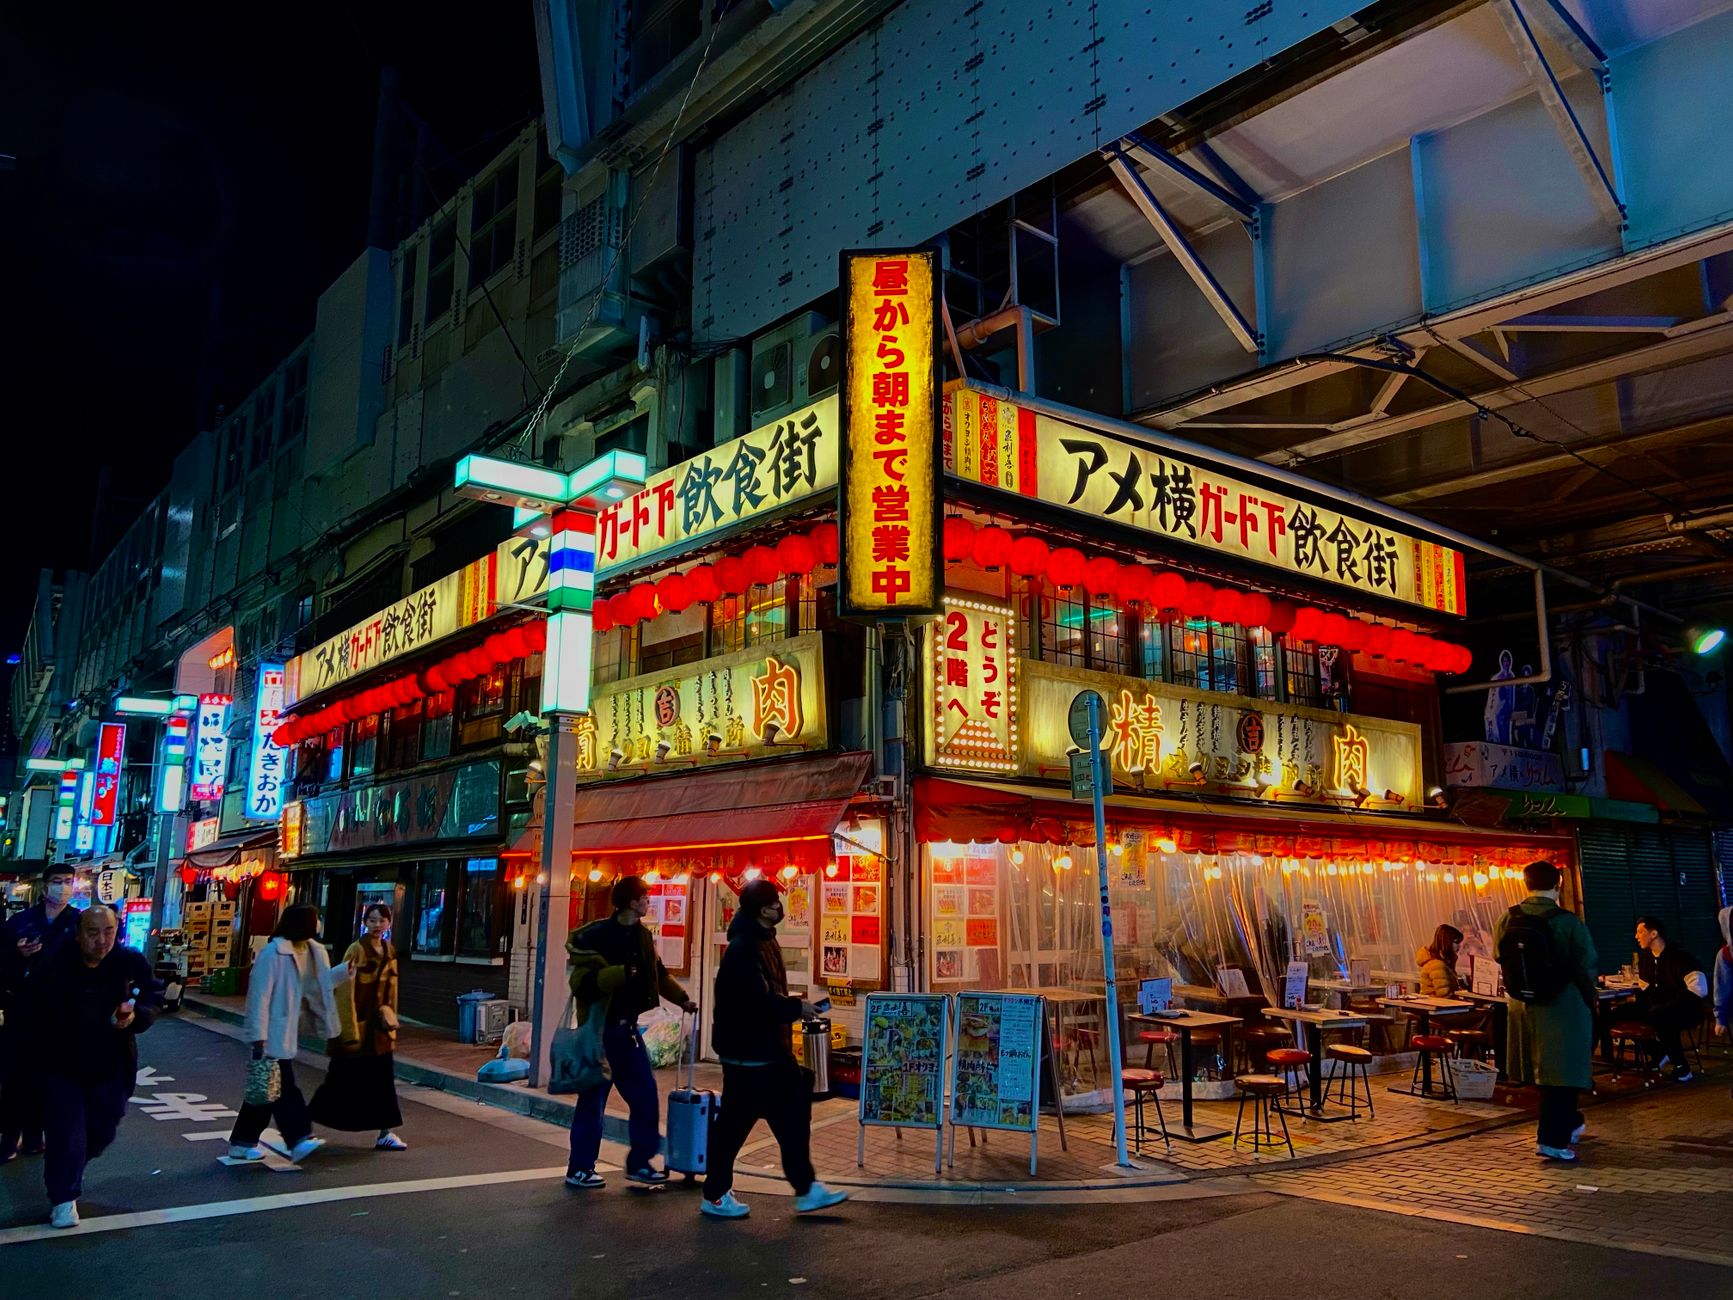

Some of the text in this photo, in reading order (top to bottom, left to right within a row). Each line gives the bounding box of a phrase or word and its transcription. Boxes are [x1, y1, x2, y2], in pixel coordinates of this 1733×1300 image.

[872, 260, 911, 604] 昼から朝まで営業中
[511, 410, 823, 600] アメガード下飲食街
[1059, 437, 1400, 596] アメ横ガード下飲食街
[313, 586, 437, 692] アメ横ガード下飲食街
[946, 611, 970, 719] 2階へ
[980, 620, 1002, 719] どうぞ
[751, 657, 799, 739] 肉
[1111, 689, 1165, 776] 精
[1331, 723, 1370, 793] 肉
